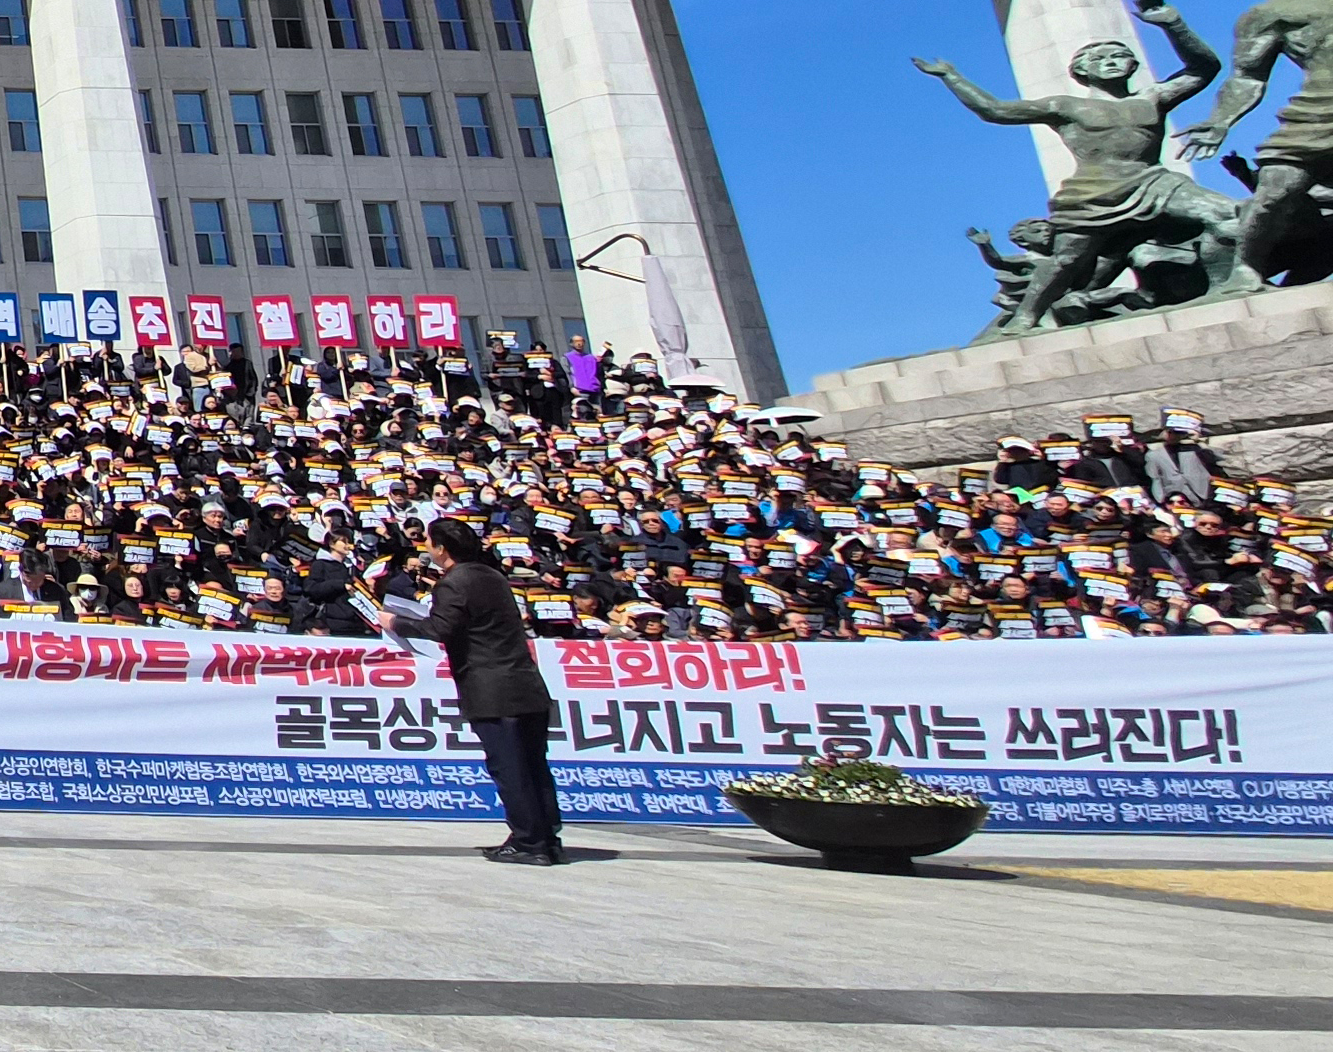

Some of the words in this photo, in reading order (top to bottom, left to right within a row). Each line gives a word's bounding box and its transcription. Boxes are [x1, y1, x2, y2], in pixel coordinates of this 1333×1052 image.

[201, 643, 418, 690] 새벽배송
[274, 694, 488, 755] 골목상권
[757, 702, 987, 763] 노동자는
[1004, 706, 1244, 767] 쓰러진다!
[62, 782, 215, 807] 국회소상공인민생포럼,
[218, 786, 373, 810] 소상공인미래전략포럼,
[95, 757, 294, 784] 한국수퍼마켓협동조합연합회,
[296, 762, 425, 786] 한국외식업중앙회,
[1241, 780, 1333, 803] CU가맹점주
